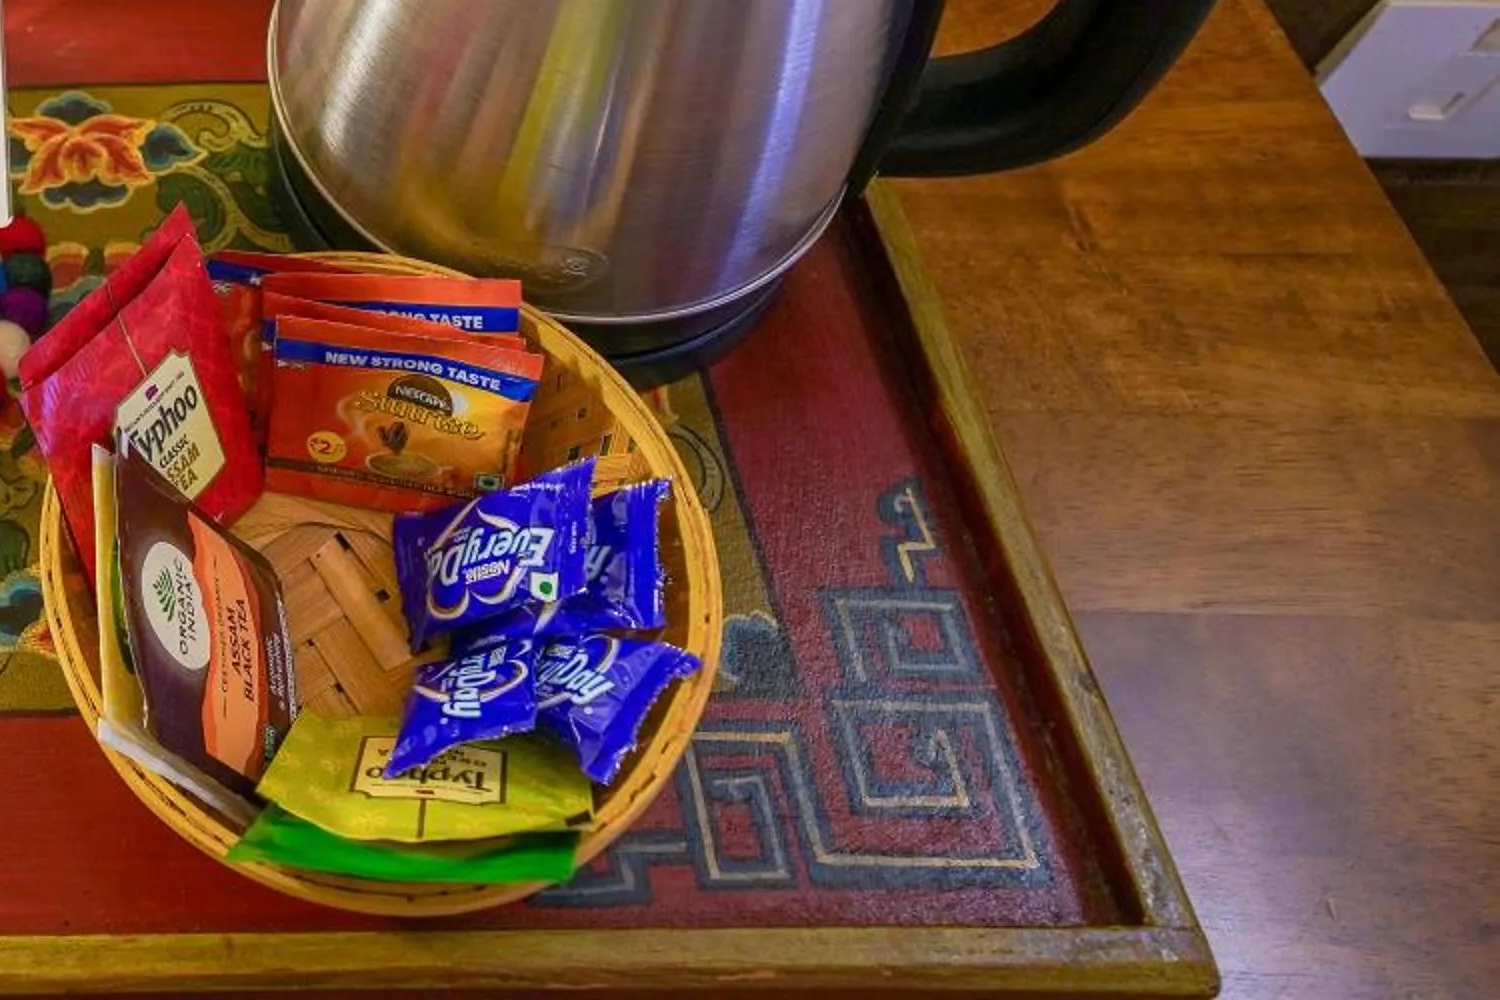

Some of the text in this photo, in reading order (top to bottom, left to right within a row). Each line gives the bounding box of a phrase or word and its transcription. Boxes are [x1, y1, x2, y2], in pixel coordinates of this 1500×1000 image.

[429, 313, 484, 329] TASTE
[325, 350, 367, 368] NEW
[371, 355, 444, 376] STRONG
[447, 366, 502, 391] TASTE
[166, 442, 201, 482] SSAM
[172, 468, 199, 492] EA
[174, 555, 189, 655] ORGANIC
[184, 581, 197, 642] INDIA
[226, 607, 243, 676] ASSAM
[235, 599, 255, 703] BLACK TEA
[366, 765, 493, 793] Typho
